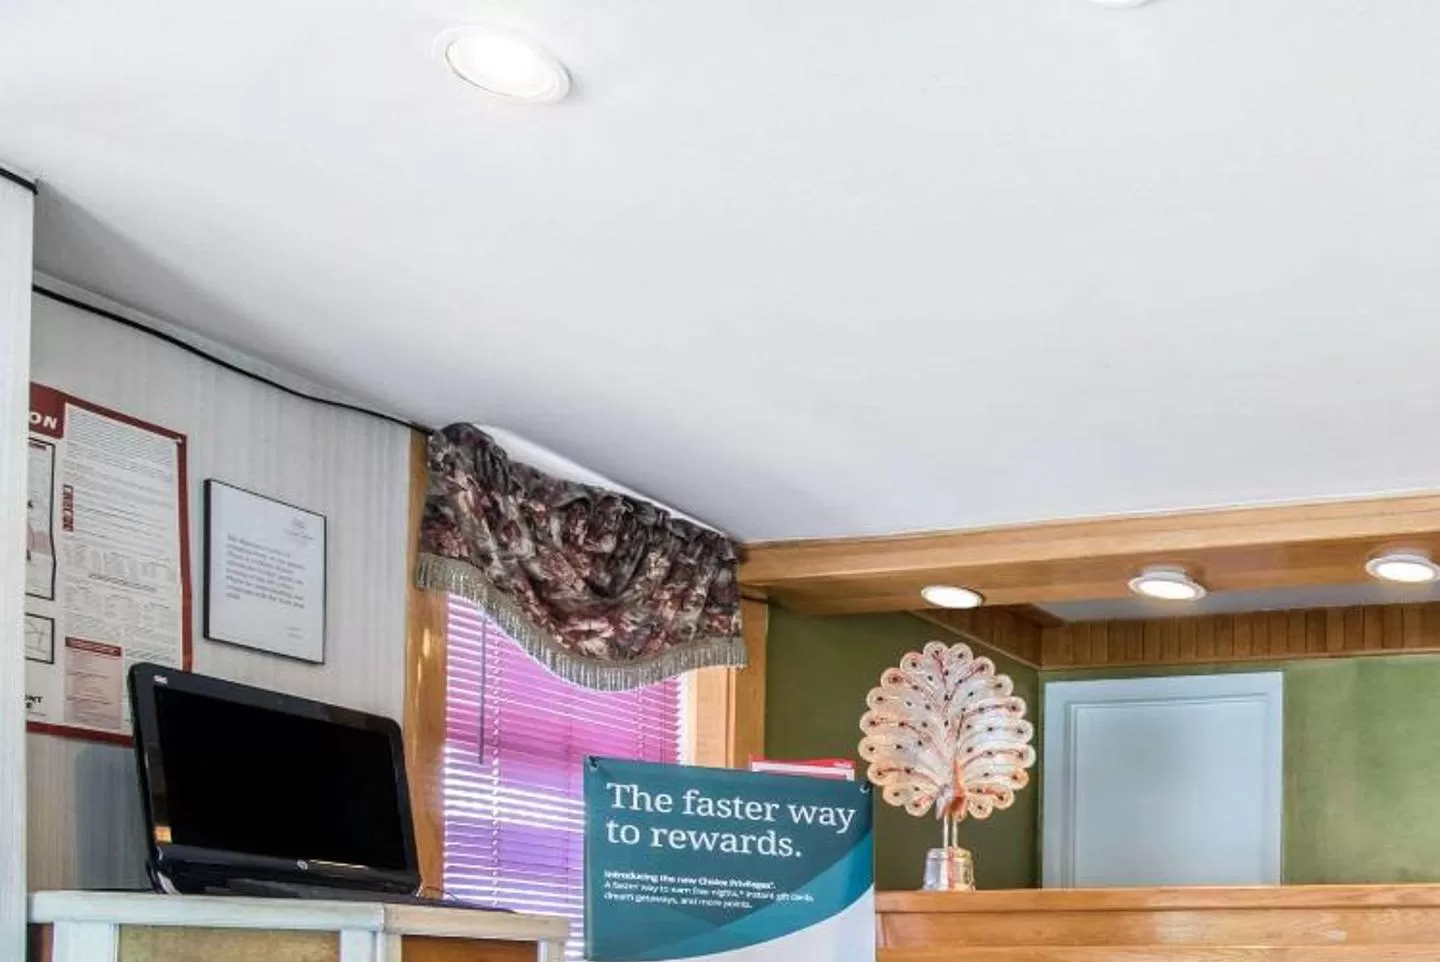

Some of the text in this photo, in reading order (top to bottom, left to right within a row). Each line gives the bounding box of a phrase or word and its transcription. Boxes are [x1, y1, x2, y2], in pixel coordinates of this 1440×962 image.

[29, 411, 58, 430] ON
[606, 782, 856, 834] The faster way
[606, 819, 802, 857] to rewards.
[604, 870, 659, 883] Introducing
[660, 874, 676, 883] the
[678, 876, 697, 884] new
[698, 877, 728, 886] Choice
[641, 885, 658, 893] way
